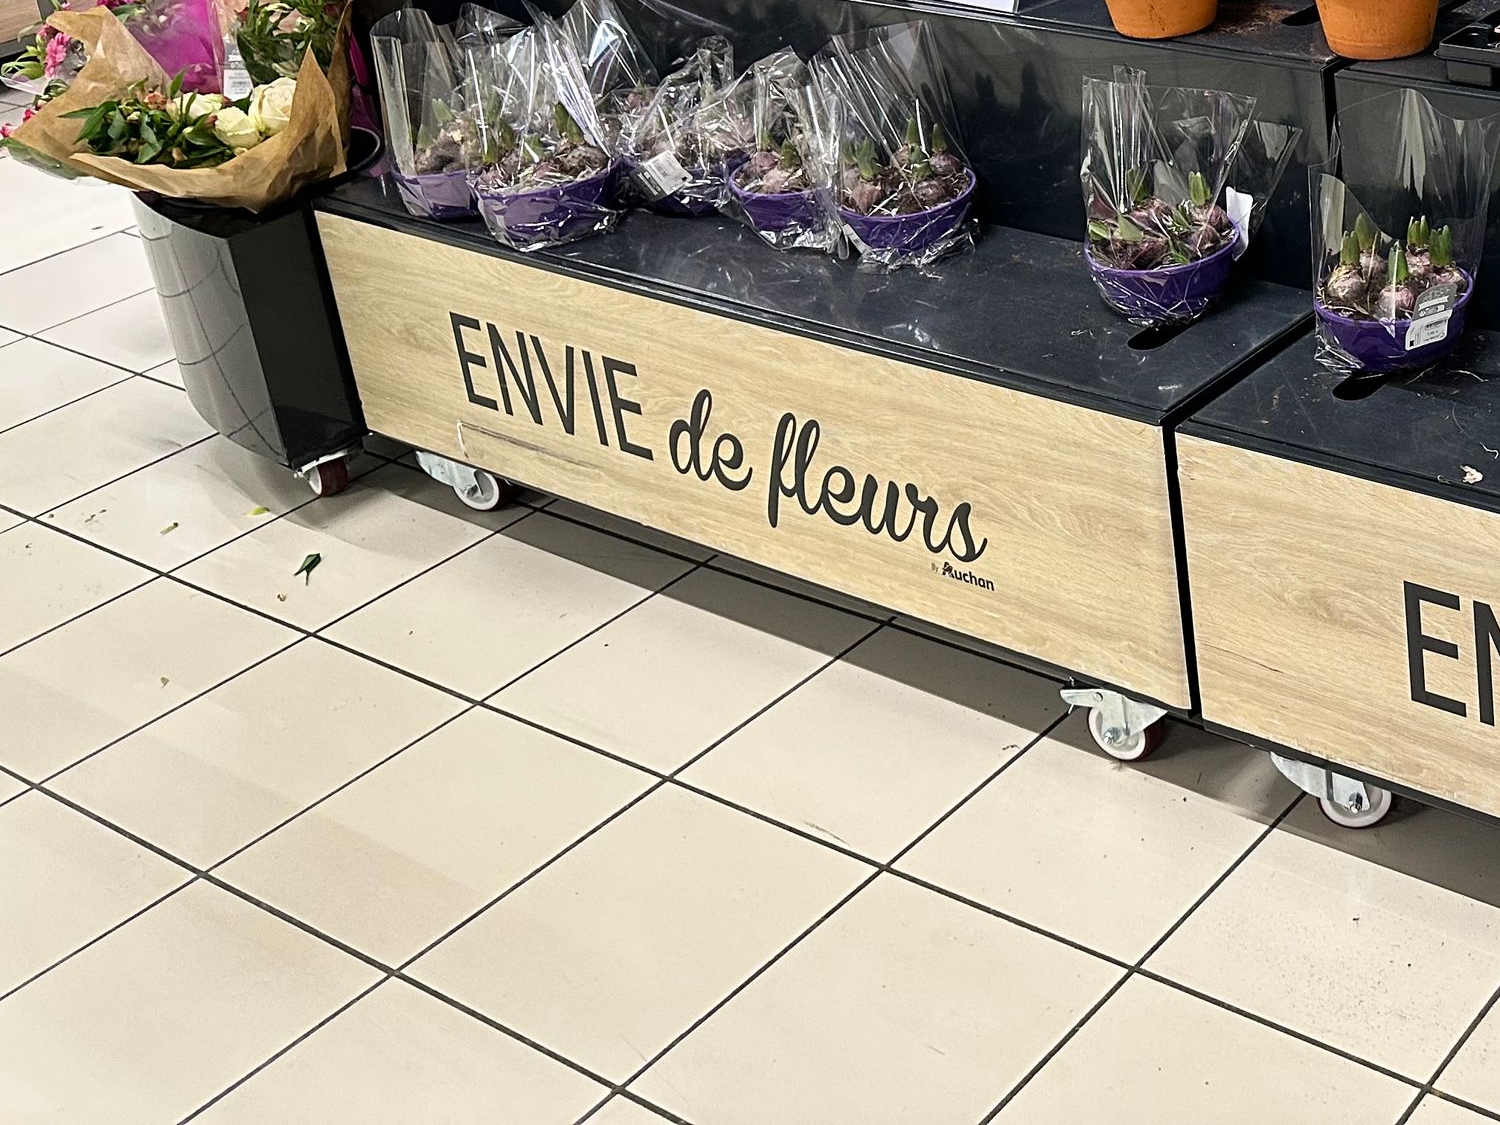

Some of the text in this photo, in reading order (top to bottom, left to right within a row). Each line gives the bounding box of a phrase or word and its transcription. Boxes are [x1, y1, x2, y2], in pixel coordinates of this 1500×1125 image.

[449, 311, 988, 563] ENVIE de fleurs
[931, 561, 995, 591] By Auchan
